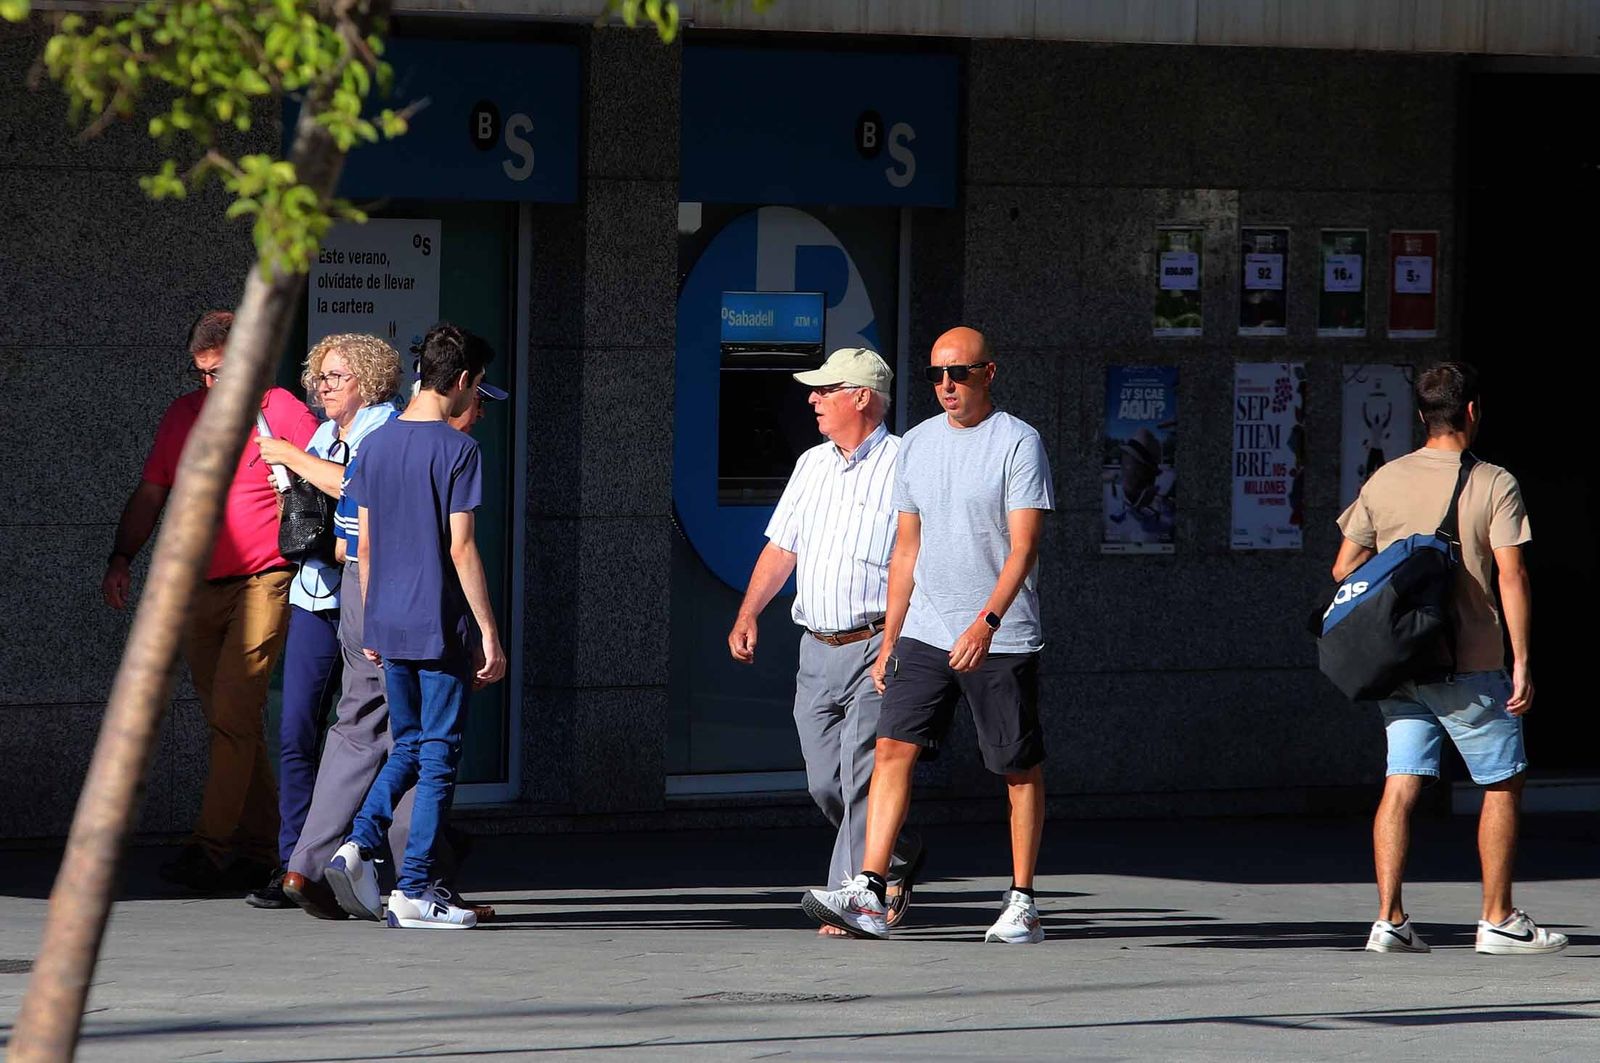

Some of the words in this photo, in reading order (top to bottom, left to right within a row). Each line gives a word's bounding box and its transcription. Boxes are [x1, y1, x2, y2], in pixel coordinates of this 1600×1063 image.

[319, 248, 344, 264] Este
[348, 251, 390, 267] verano,
[318, 272, 363, 290] olvídate
[366, 273, 381, 290] de
[384, 273, 415, 290] llevar
[1258, 267, 1272, 279] 92
[317, 297, 328, 313] la
[332, 298, 374, 314] cartera
[794, 315, 811, 328] ATM
[1144, 388, 1165, 400] CAE
[1236, 395, 1270, 421] SEP
[1236, 424, 1281, 450] TIEM
[1236, 451, 1271, 477] BRE
[1244, 480, 1286, 495] MILLONES
